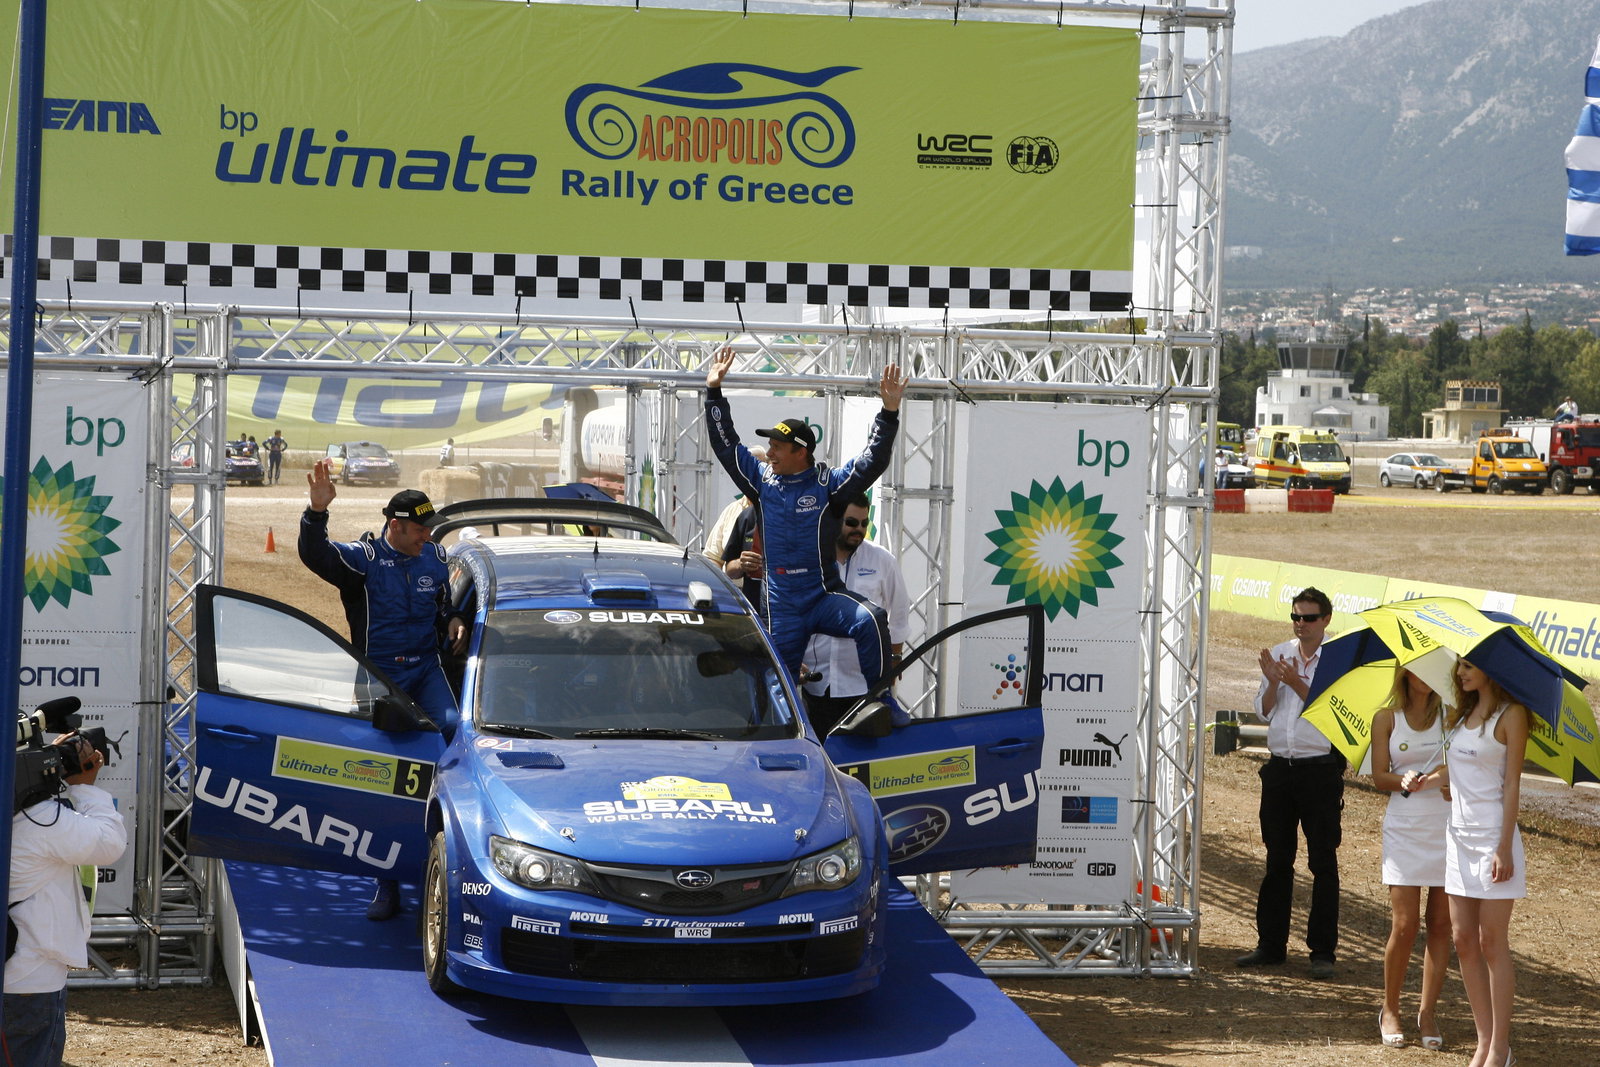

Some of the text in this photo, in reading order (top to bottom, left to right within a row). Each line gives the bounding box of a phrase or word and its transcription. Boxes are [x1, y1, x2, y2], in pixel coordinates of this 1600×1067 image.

[219, 103, 258, 137] bp
[638, 113, 784, 166] ACROPOLIS
[917, 132, 993, 154] WRC
[215, 126, 538, 194] ultimate
[932, 156, 961, 164] WORLD
[962, 157, 991, 165] RALLY
[561, 169, 854, 206] Rally of Greece
[65, 405, 127, 457] bp
[1076, 428, 1131, 478] bp
[588, 611, 705, 626] SUBARU
[1423, 602, 1481, 639] ultimate
[1059, 748, 1112, 767] PUMA
[279, 757, 339, 778] ultimate
[950, 771, 970, 780] Greece
[341, 772, 359, 782] Rally
[367, 777, 390, 787] Greece
[405, 763, 421, 796] 5
[873, 772, 925, 790] ultimate
[195, 765, 403, 870] UBARU
[582, 799, 774, 817] SUBARU
[586, 811, 777, 825] WORLD RALLY TEAM
[461, 882, 492, 896] DENSO
[463, 912, 483, 926] PIA
[510, 914, 562, 936] PIRELLI
[569, 910, 610, 924] MOTUL
[642, 917, 746, 929] STI Performance
[778, 912, 815, 925] MOTUL
[819, 915, 858, 935] PIRELLI
[678, 928, 709, 937] 1 WRC
